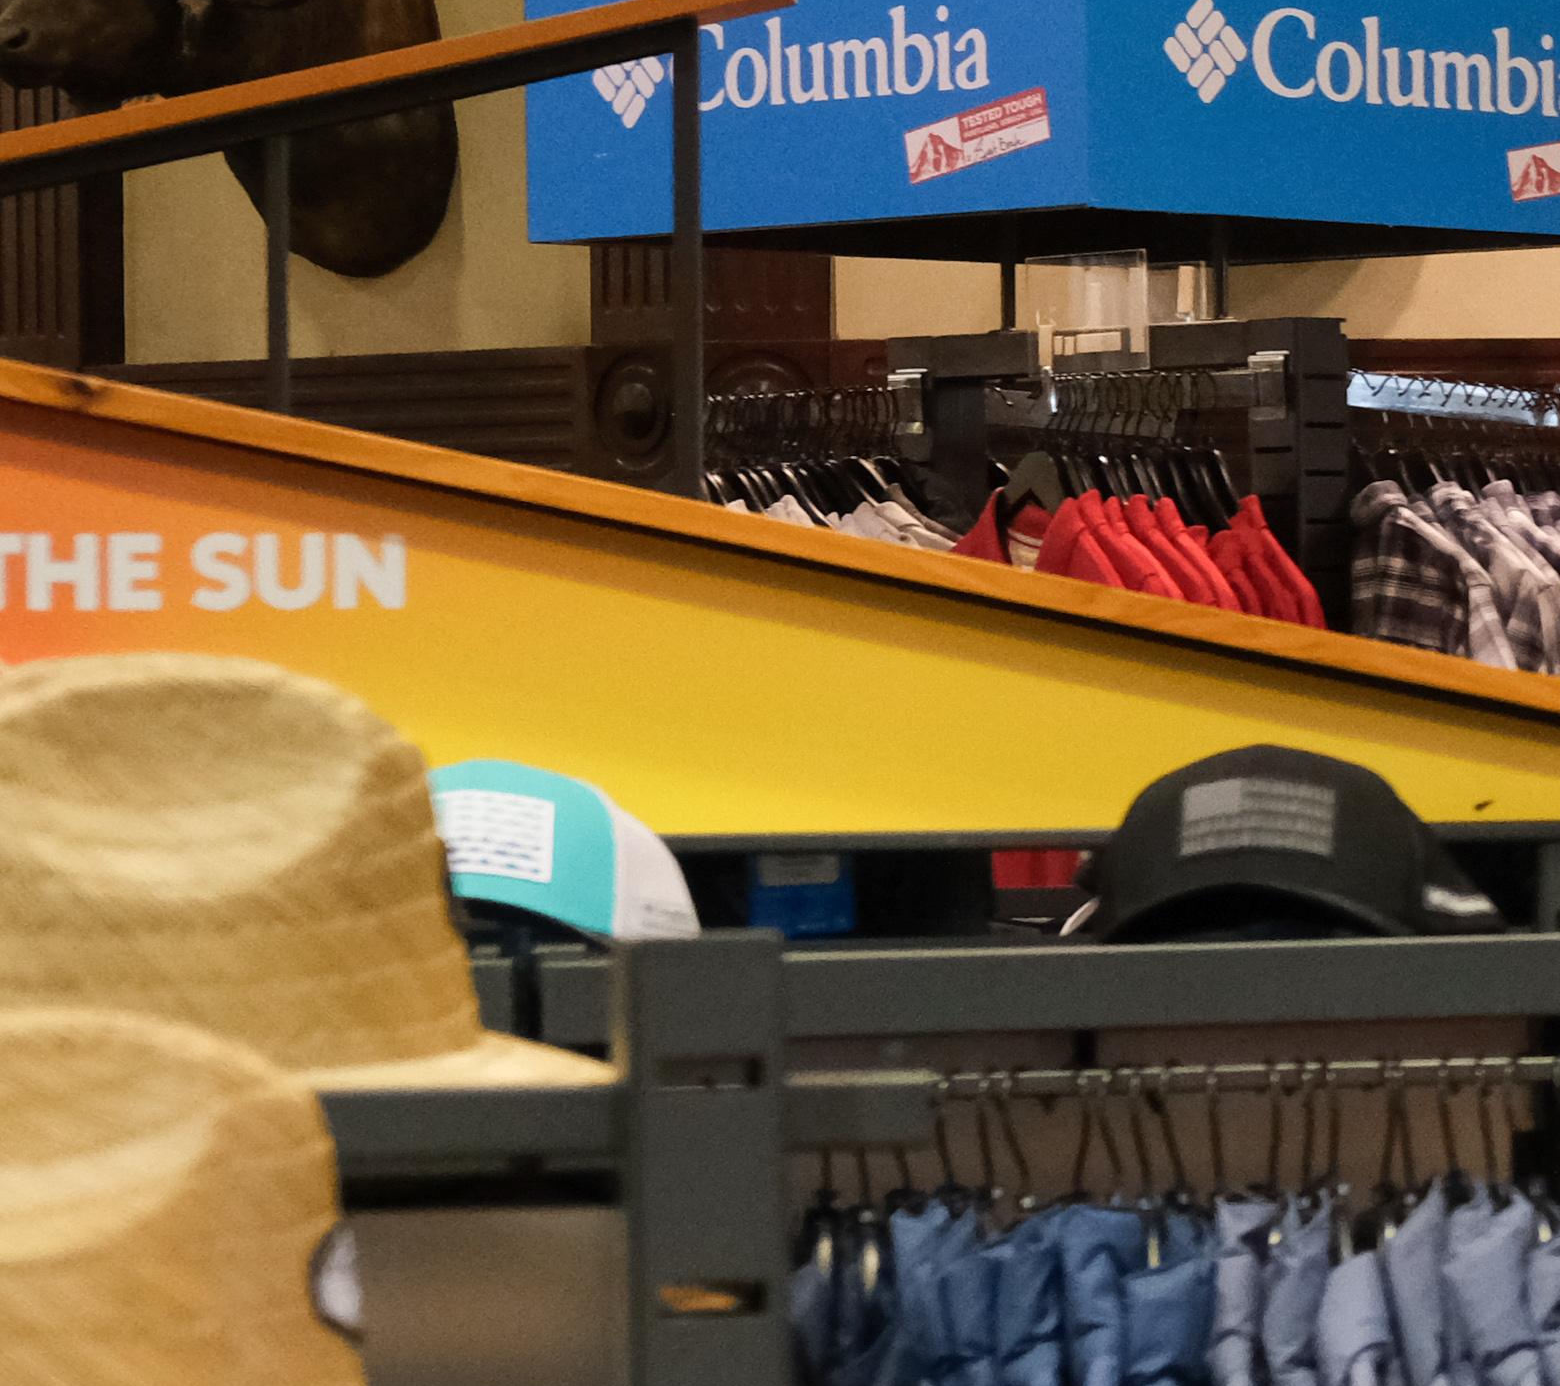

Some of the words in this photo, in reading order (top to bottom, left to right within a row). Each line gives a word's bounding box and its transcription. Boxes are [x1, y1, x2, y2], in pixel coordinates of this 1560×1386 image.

[960, 106, 1003, 129] TESTED
[1004, 92, 1043, 115] TOUGH
[189, 531, 408, 611] SUN
